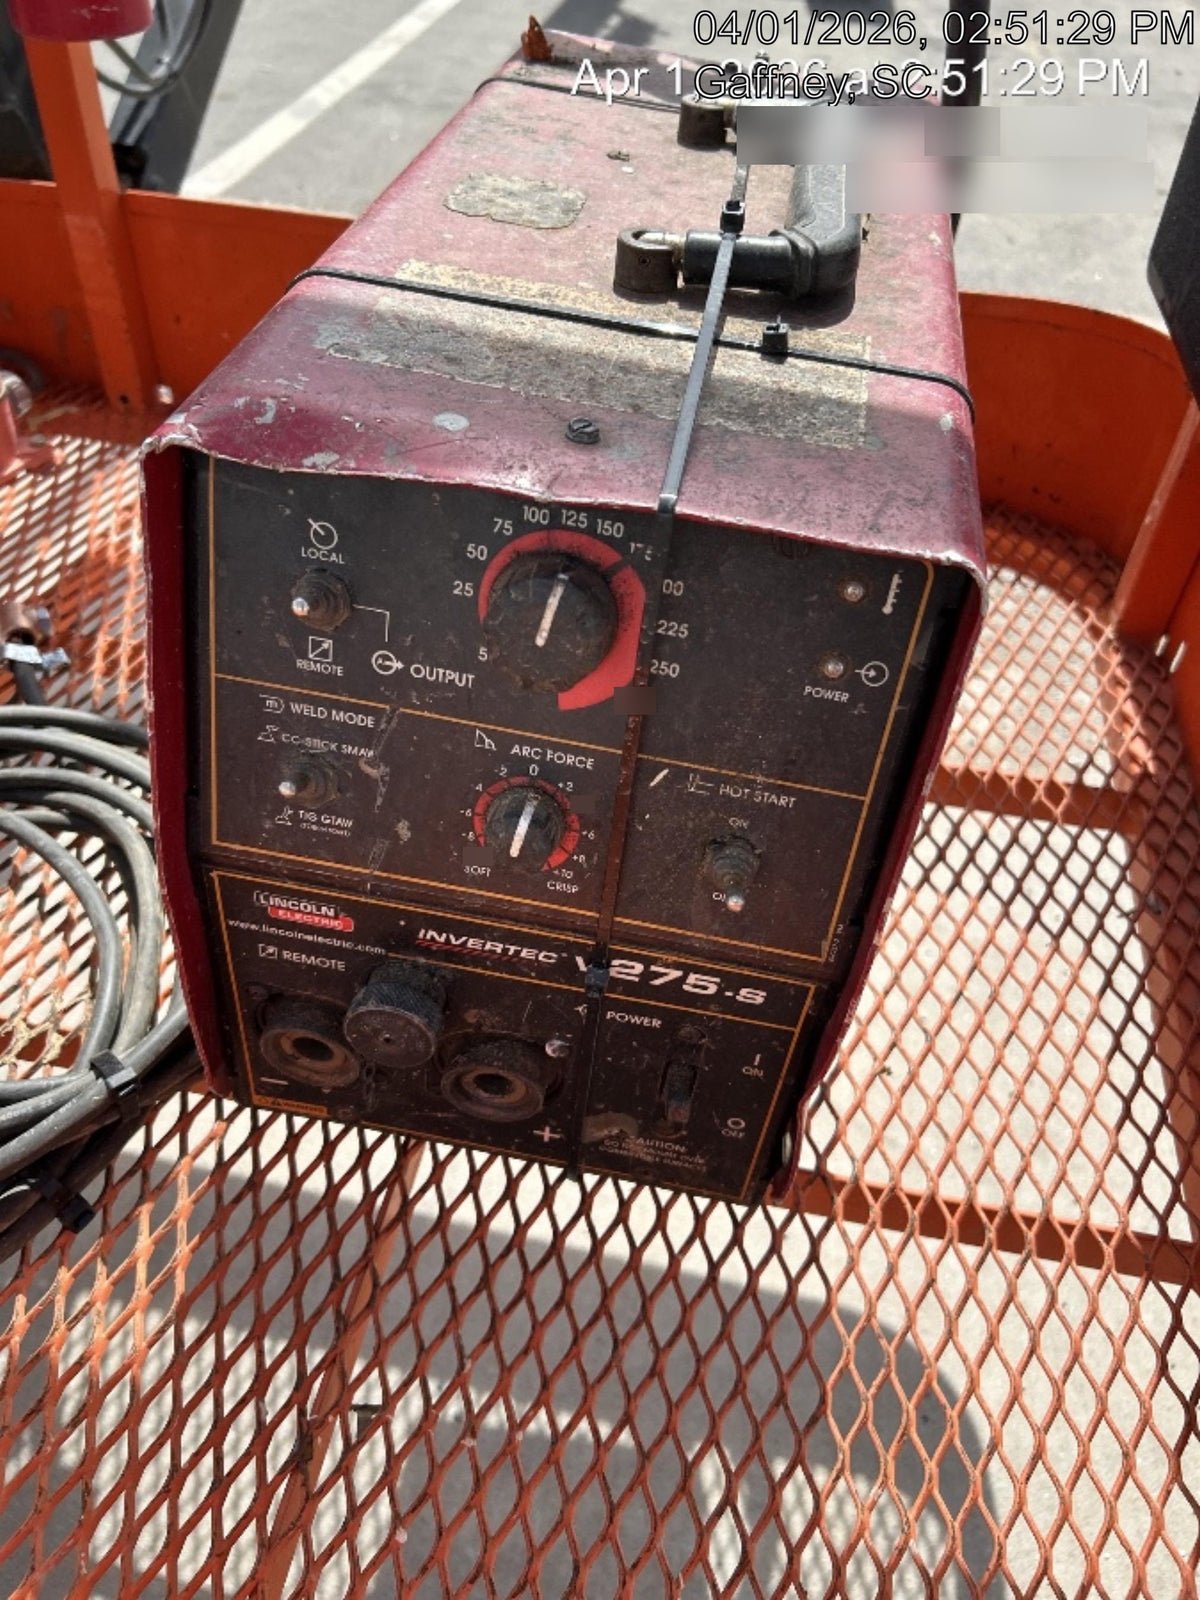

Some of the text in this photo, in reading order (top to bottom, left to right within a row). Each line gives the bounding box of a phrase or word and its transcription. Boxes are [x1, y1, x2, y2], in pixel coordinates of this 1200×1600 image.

[523, 505, 550, 525] 100
[561, 509, 588, 529] 125
[493, 518, 513, 536] 75
[597, 518, 624, 538] 150
[301, 548, 345, 565] LOCAL
[467, 543, 488, 561] 50
[453, 580, 474, 597] 25
[662, 579, 684, 596] 00
[657, 620, 689, 638] 225
[478, 646, 488, 661] 5
[296, 658, 344, 676] REMOTE
[410, 664, 475, 688] OUTPUT
[650, 658, 680, 678] 250
[803, 685, 850, 703] POWER
[289, 701, 375, 728] WELD MODE
[510, 744, 594, 770] ARC FORCE
[529, 764, 540, 776] 0
[557, 780, 574, 792] +2
[719, 784, 796, 809] HOT START
[547, 880, 580, 894] CRISP
[260, 892, 335, 917] LINCOLN
[278, 909, 344, 930] ELECTRIC
[418, 928, 558, 963] INVERTEC
[282, 950, 347, 972] REMOTE
[606, 1010, 662, 1029] POWER
